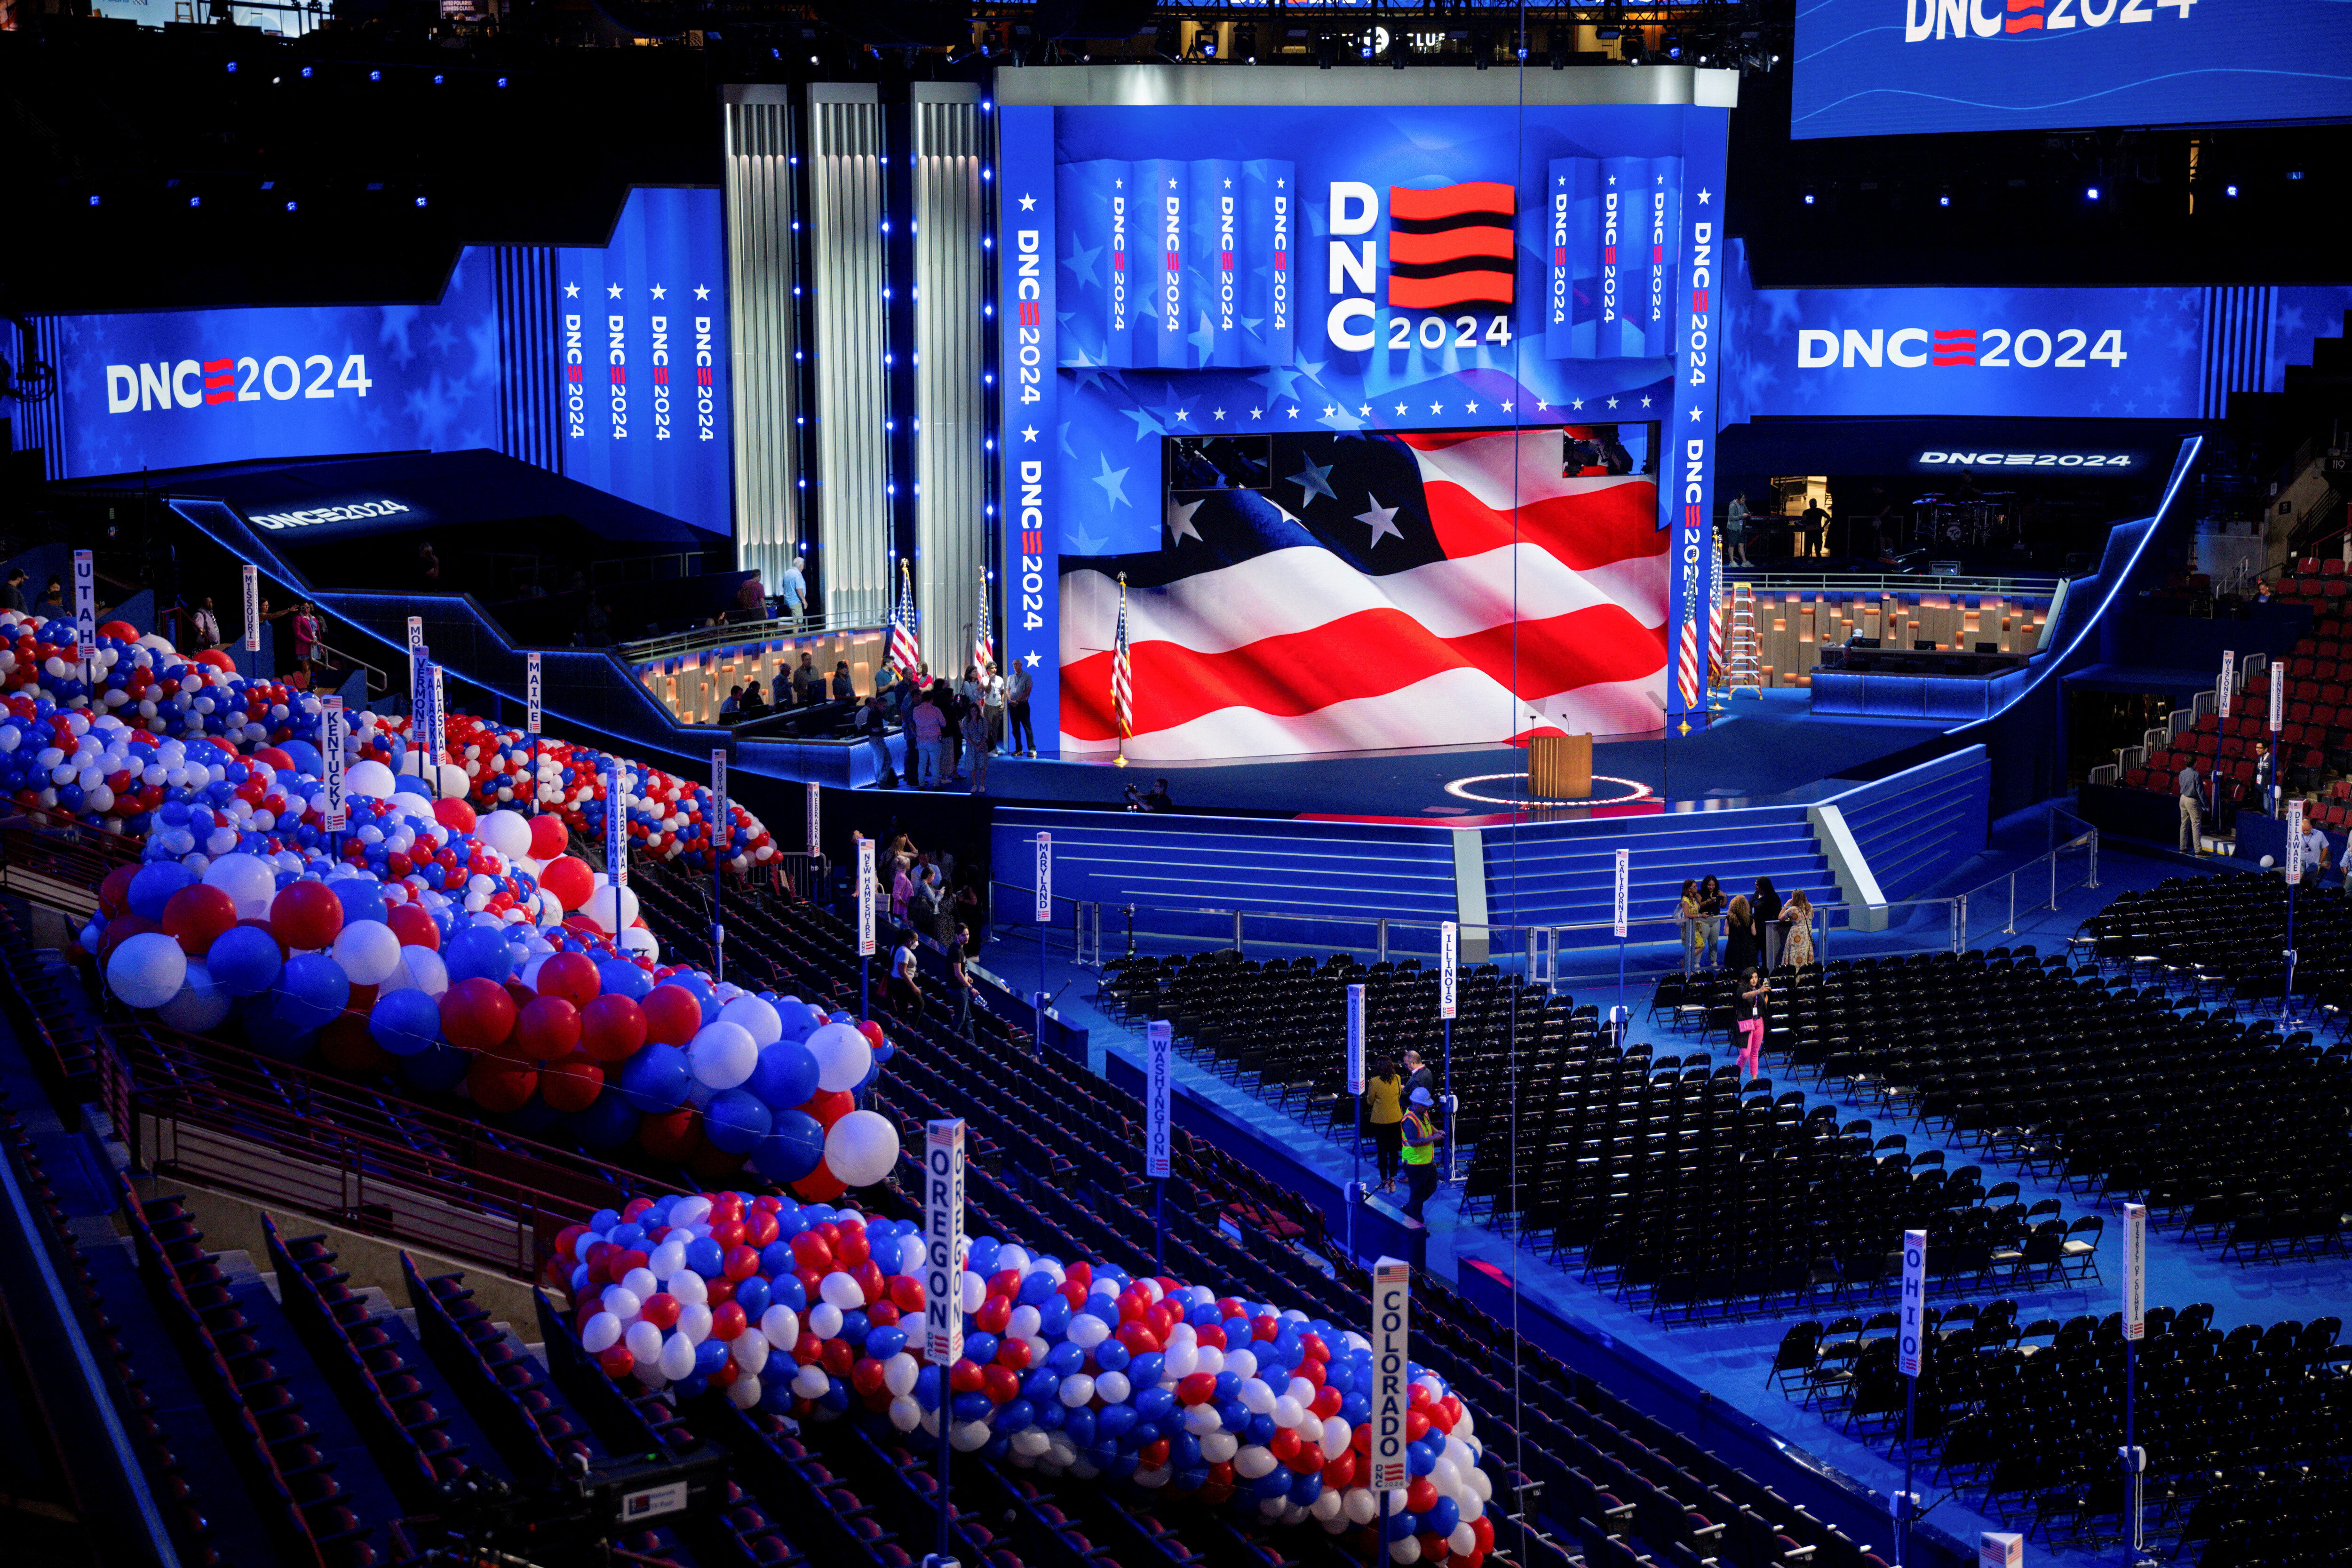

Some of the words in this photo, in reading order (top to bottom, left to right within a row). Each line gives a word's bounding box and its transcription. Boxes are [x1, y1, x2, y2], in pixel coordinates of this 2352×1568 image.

[1327, 182, 1379, 351] DNC
[1388, 316, 1512, 349] 2024
[2333, 460, 2345, 469] 119
[78, 564, 93, 643] UTAH
[245, 575, 254, 639] MISSOURI
[415, 658, 426, 729] VERMONT
[428, 678, 437, 751] ALASKA
[530, 662, 539, 721] MAINE
[2222, 659, 2232, 708] WISCONSIN
[327, 712, 341, 810] KENTUCKY
[1153, 1040, 1167, 1155] WASHINGTON
[930, 1149, 949, 1329] OREGON
[954, 1148, 962, 1322] OREGON
[2135, 1265, 2139, 1275] OF
[1903, 1249, 1920, 1355] OHIO
[1380, 1290, 1401, 1457] COLORADO
